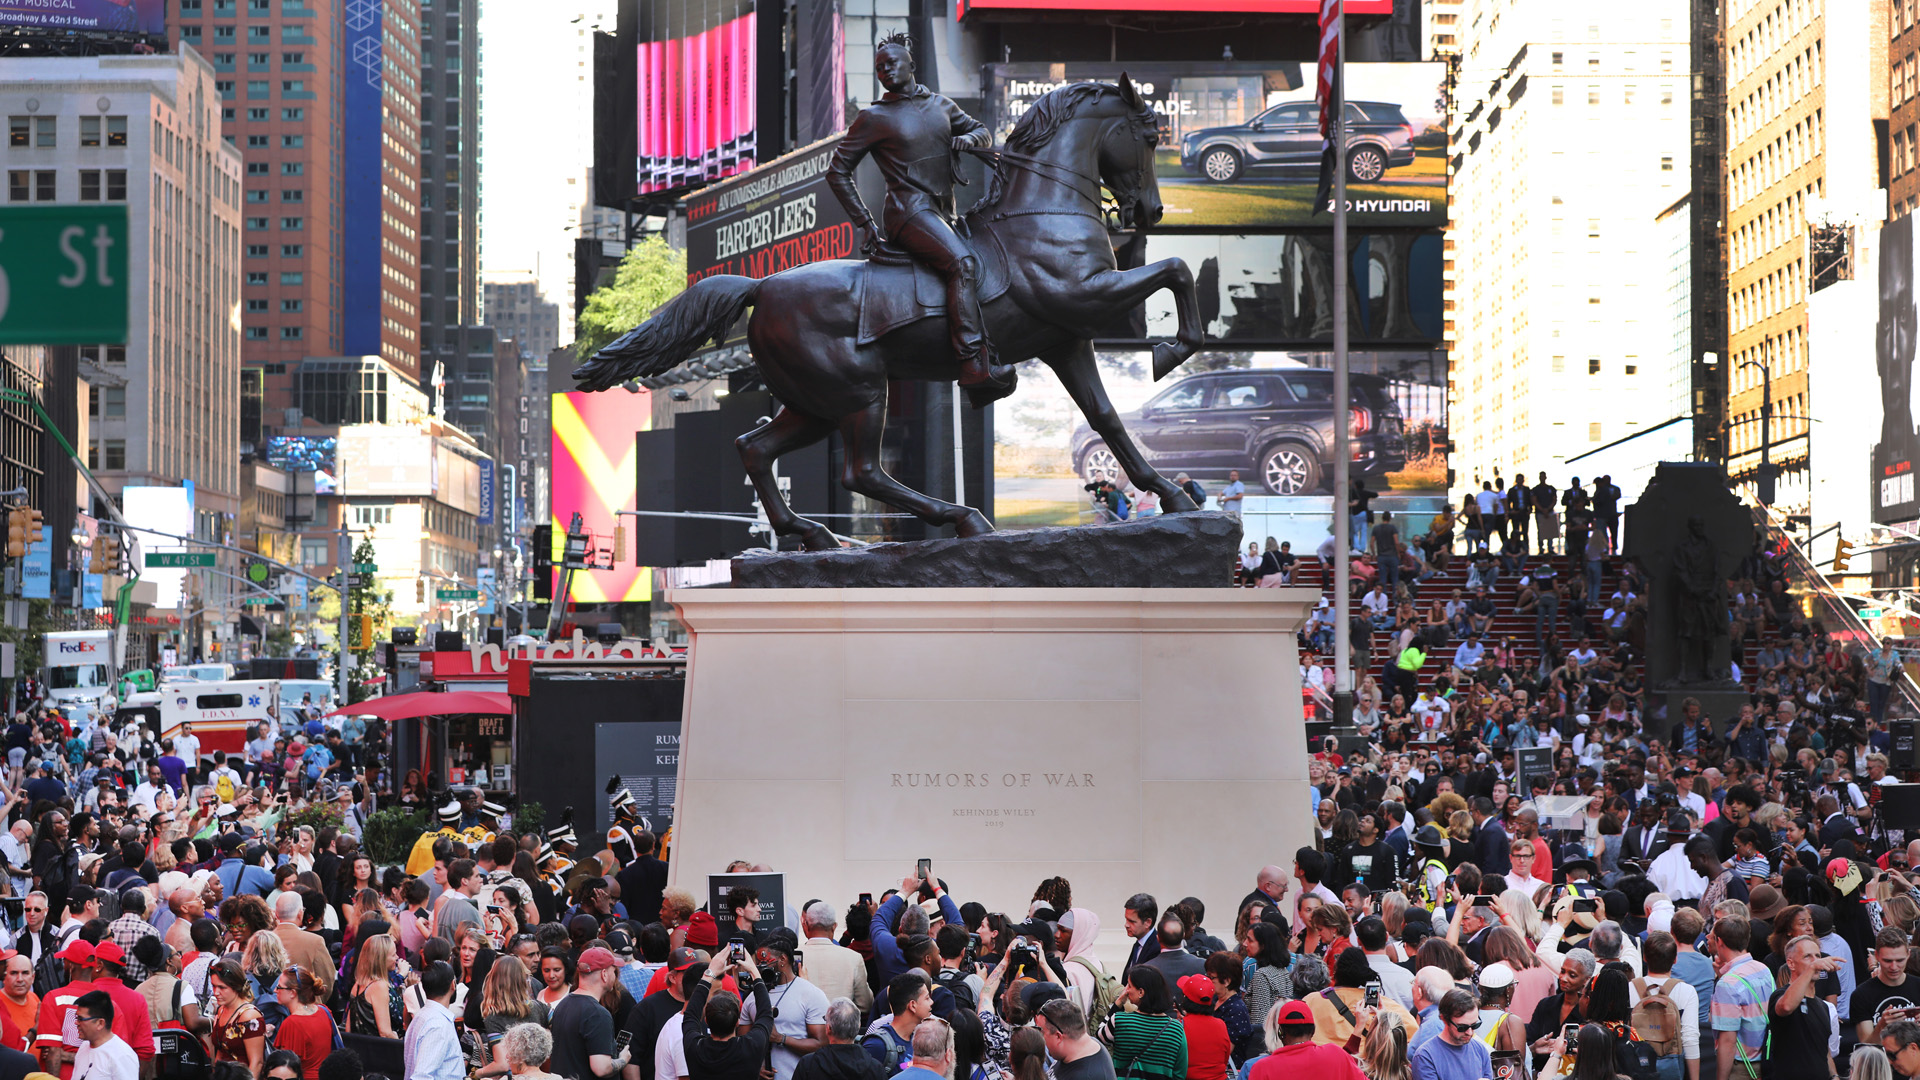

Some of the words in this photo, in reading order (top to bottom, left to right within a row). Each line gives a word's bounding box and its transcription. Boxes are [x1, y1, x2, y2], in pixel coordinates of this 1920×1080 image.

[25, 0, 75, 9] MUSICAL
[0, 12, 39, 24] Broadway
[41, 15, 47, 23] &
[49, 15, 70, 24] 42nd
[73, 16, 98, 26] Street
[718, 191, 729, 213] AN
[730, 173, 776, 207] UNMISSABLE
[776, 156, 818, 189] AMERICAN
[1355, 199, 1431, 213] HYUNDAI
[716, 209, 772, 260] HARPER
[774, 192, 817, 240] LEE'S
[58, 224, 114, 288] St
[749, 221, 854, 280] MOCKINGBIRD
[520, 396, 528, 504] COLBE
[481, 465, 490, 518] NOVOTEL
[161, 555, 171, 565] W
[174, 555, 186, 565] 47
[190, 555, 200, 565] St
[60, 641, 96, 653] FedEx
[479, 718, 504, 727] DRAFT
[479, 727, 504, 736] BEER
[656, 735, 681, 745] RUM
[656, 755, 679, 765] KEH
[891, 773, 990, 788] RUMORS
[1002, 773, 1031, 788] OF
[1043, 773, 1096, 788] WAR
[952, 809, 999, 817] KEHINDE
[1003, 809, 1036, 817] WILEY
